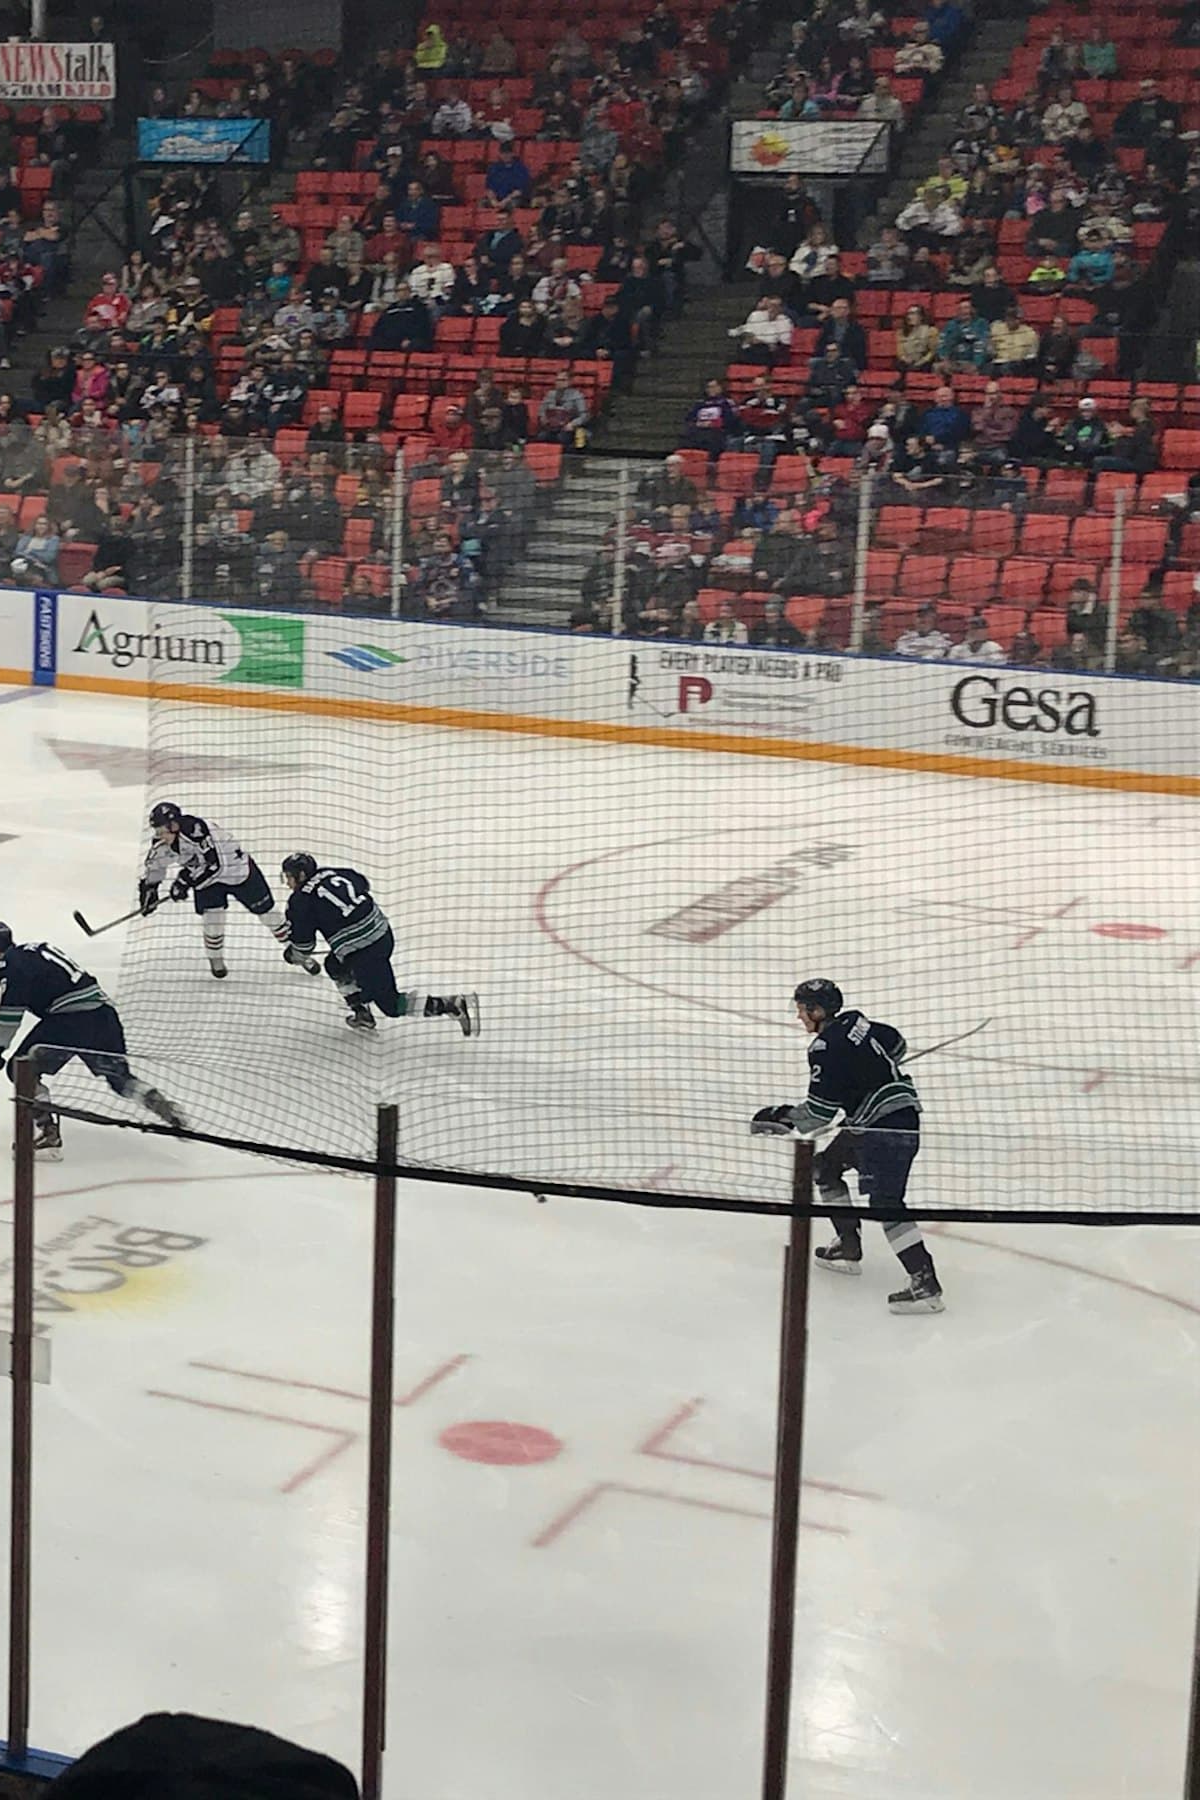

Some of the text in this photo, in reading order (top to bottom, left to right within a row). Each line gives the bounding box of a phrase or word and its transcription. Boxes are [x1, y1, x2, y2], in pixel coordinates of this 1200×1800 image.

[72, 609, 226, 668] Agrium
[951, 674, 1102, 738] Gesa
[316, 875, 367, 917] 12
